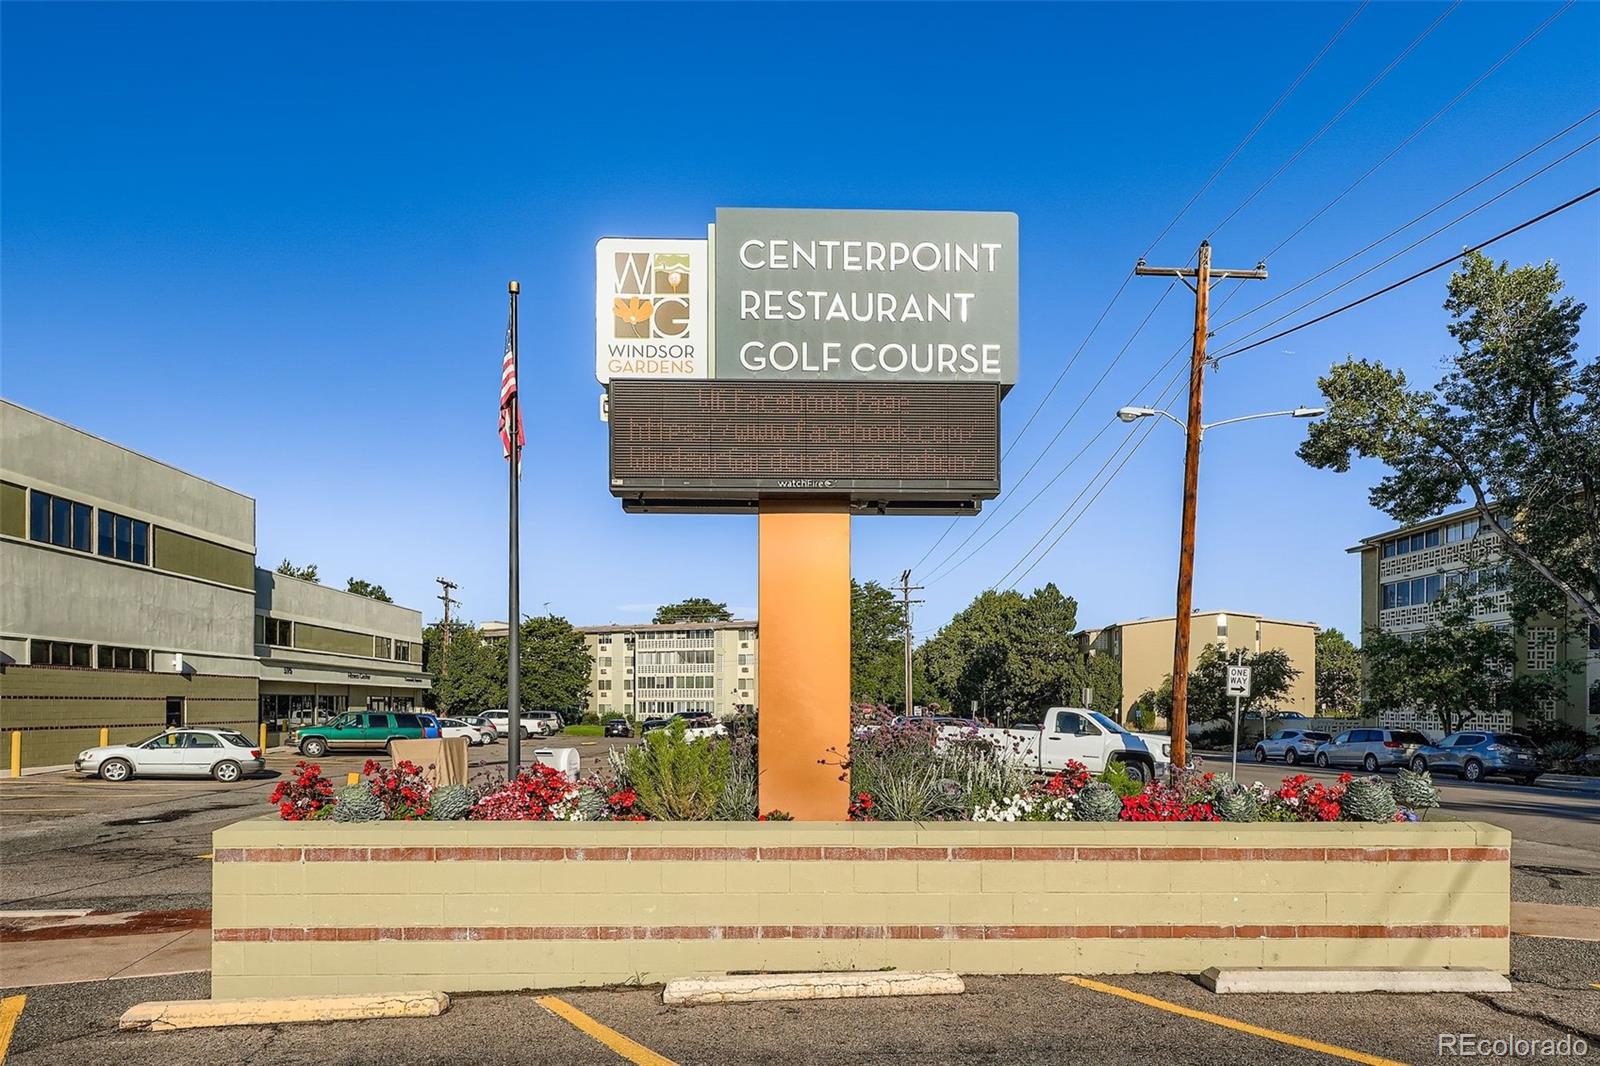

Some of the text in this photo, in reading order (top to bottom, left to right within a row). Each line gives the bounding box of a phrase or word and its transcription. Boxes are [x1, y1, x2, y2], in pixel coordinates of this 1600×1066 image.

[738, 239, 1002, 273] CENTERPOINT
[739, 289, 976, 324] RESTAURANT
[608, 344, 694, 358] WINDSOR
[739, 340, 1001, 374] GOLF COURSE
[608, 359, 694, 374] GARDENS
[734, 389, 848, 414] Facebook
[1231, 669, 1248, 677] ONE
